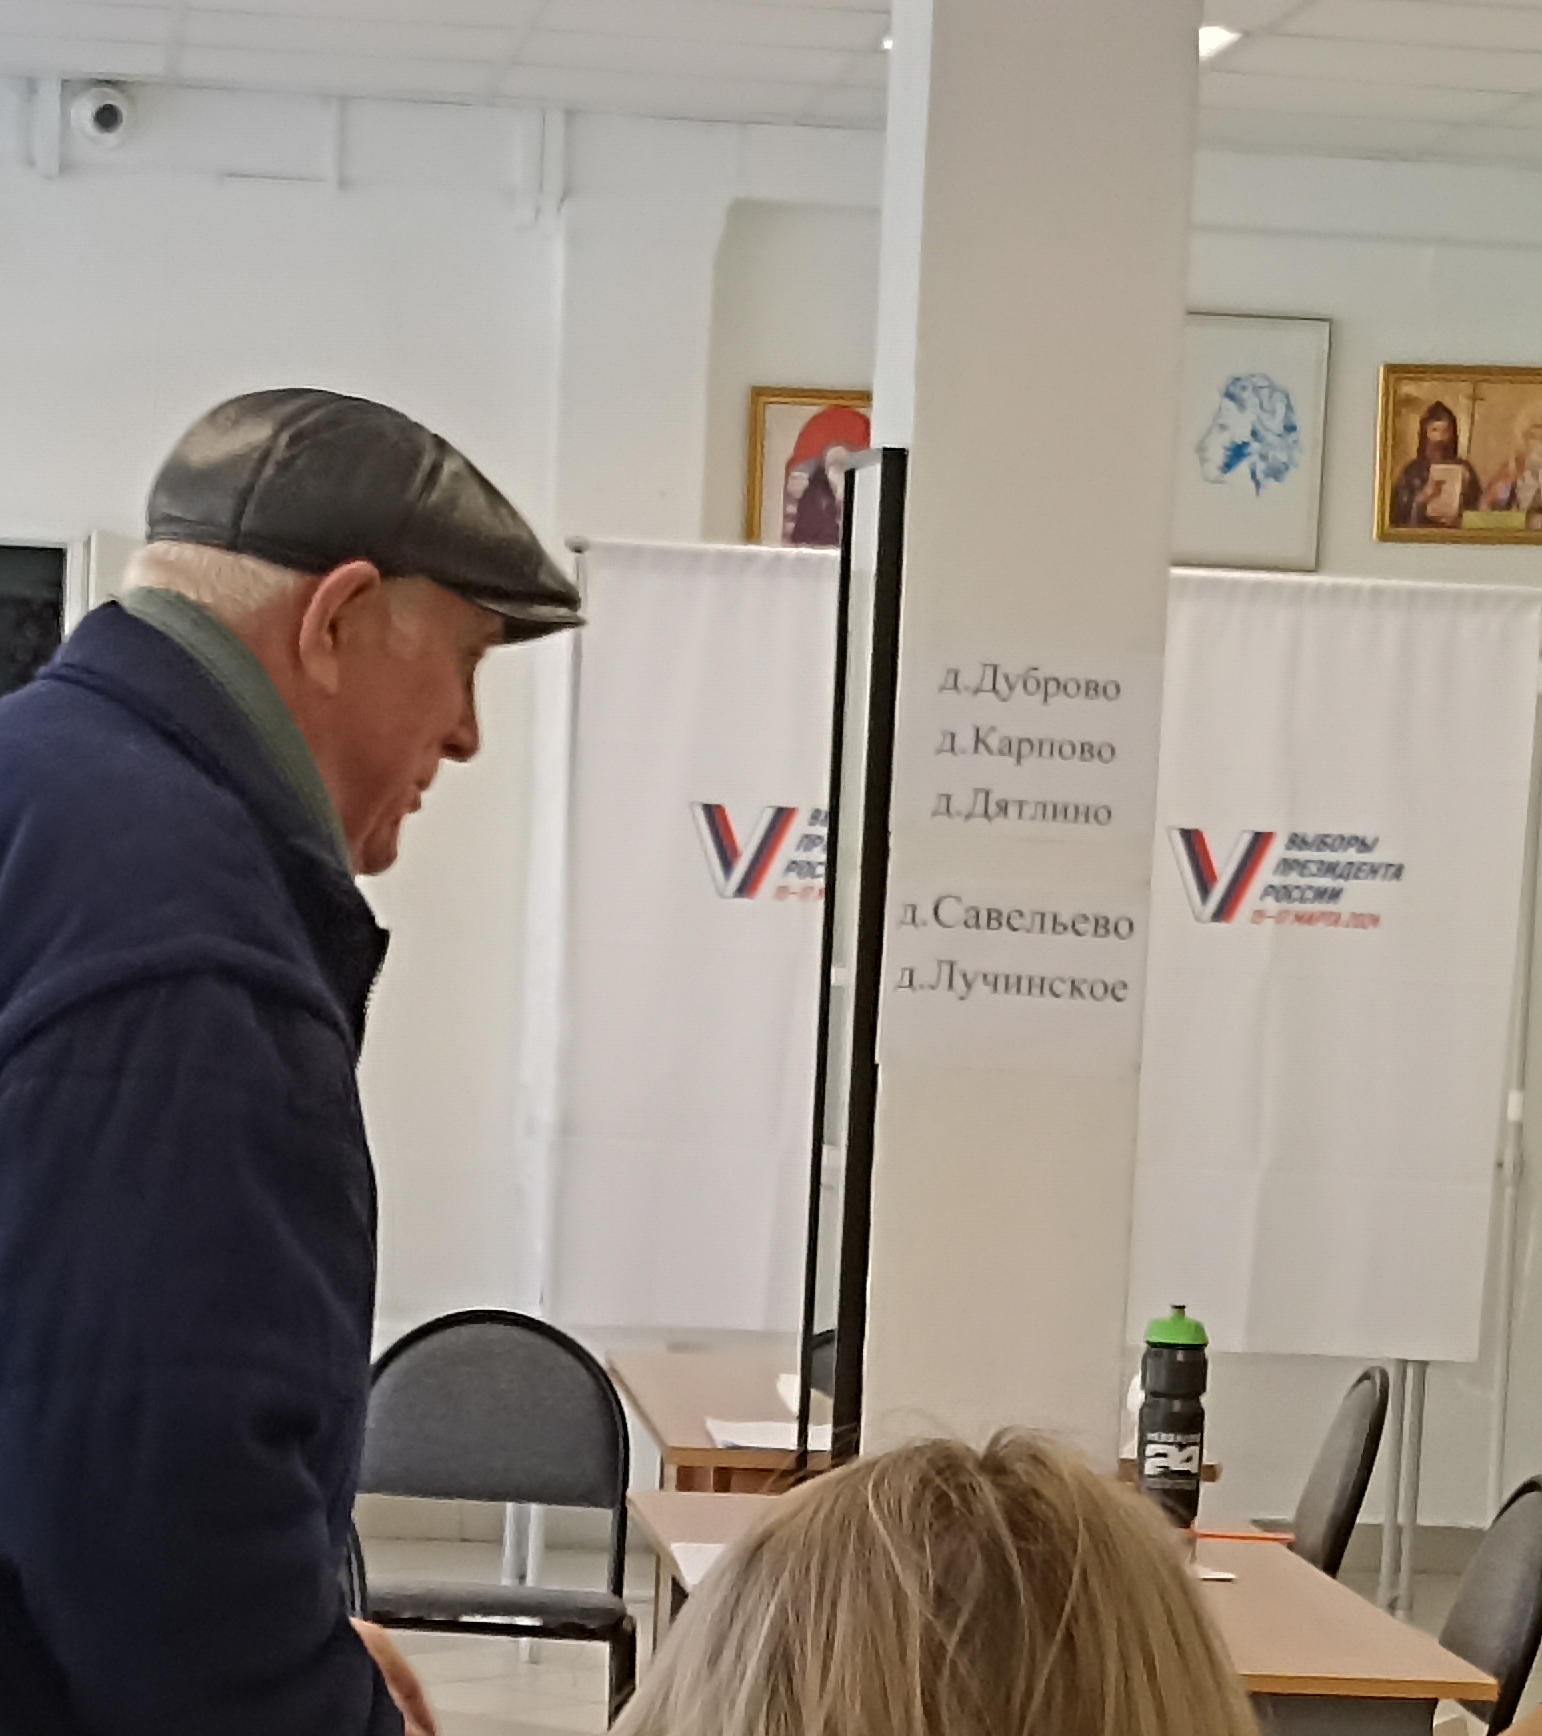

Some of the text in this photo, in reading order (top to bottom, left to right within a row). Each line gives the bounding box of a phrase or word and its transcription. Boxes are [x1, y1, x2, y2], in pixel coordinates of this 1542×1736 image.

[938, 663, 1122, 706] д.Дуброво
[934, 725, 1117, 767] д.Карпово
[930, 787, 1113, 827] д.Дятлино
[1284, 832, 1380, 853] ВЫБОРЫ
[1272, 857, 1405, 882] ПРЕЗИДЕНТА
[1259, 884, 1344, 904] РОССИИ
[897, 895, 1135, 941] д.Савельево
[895, 959, 1130, 1003] д.Лучинское
